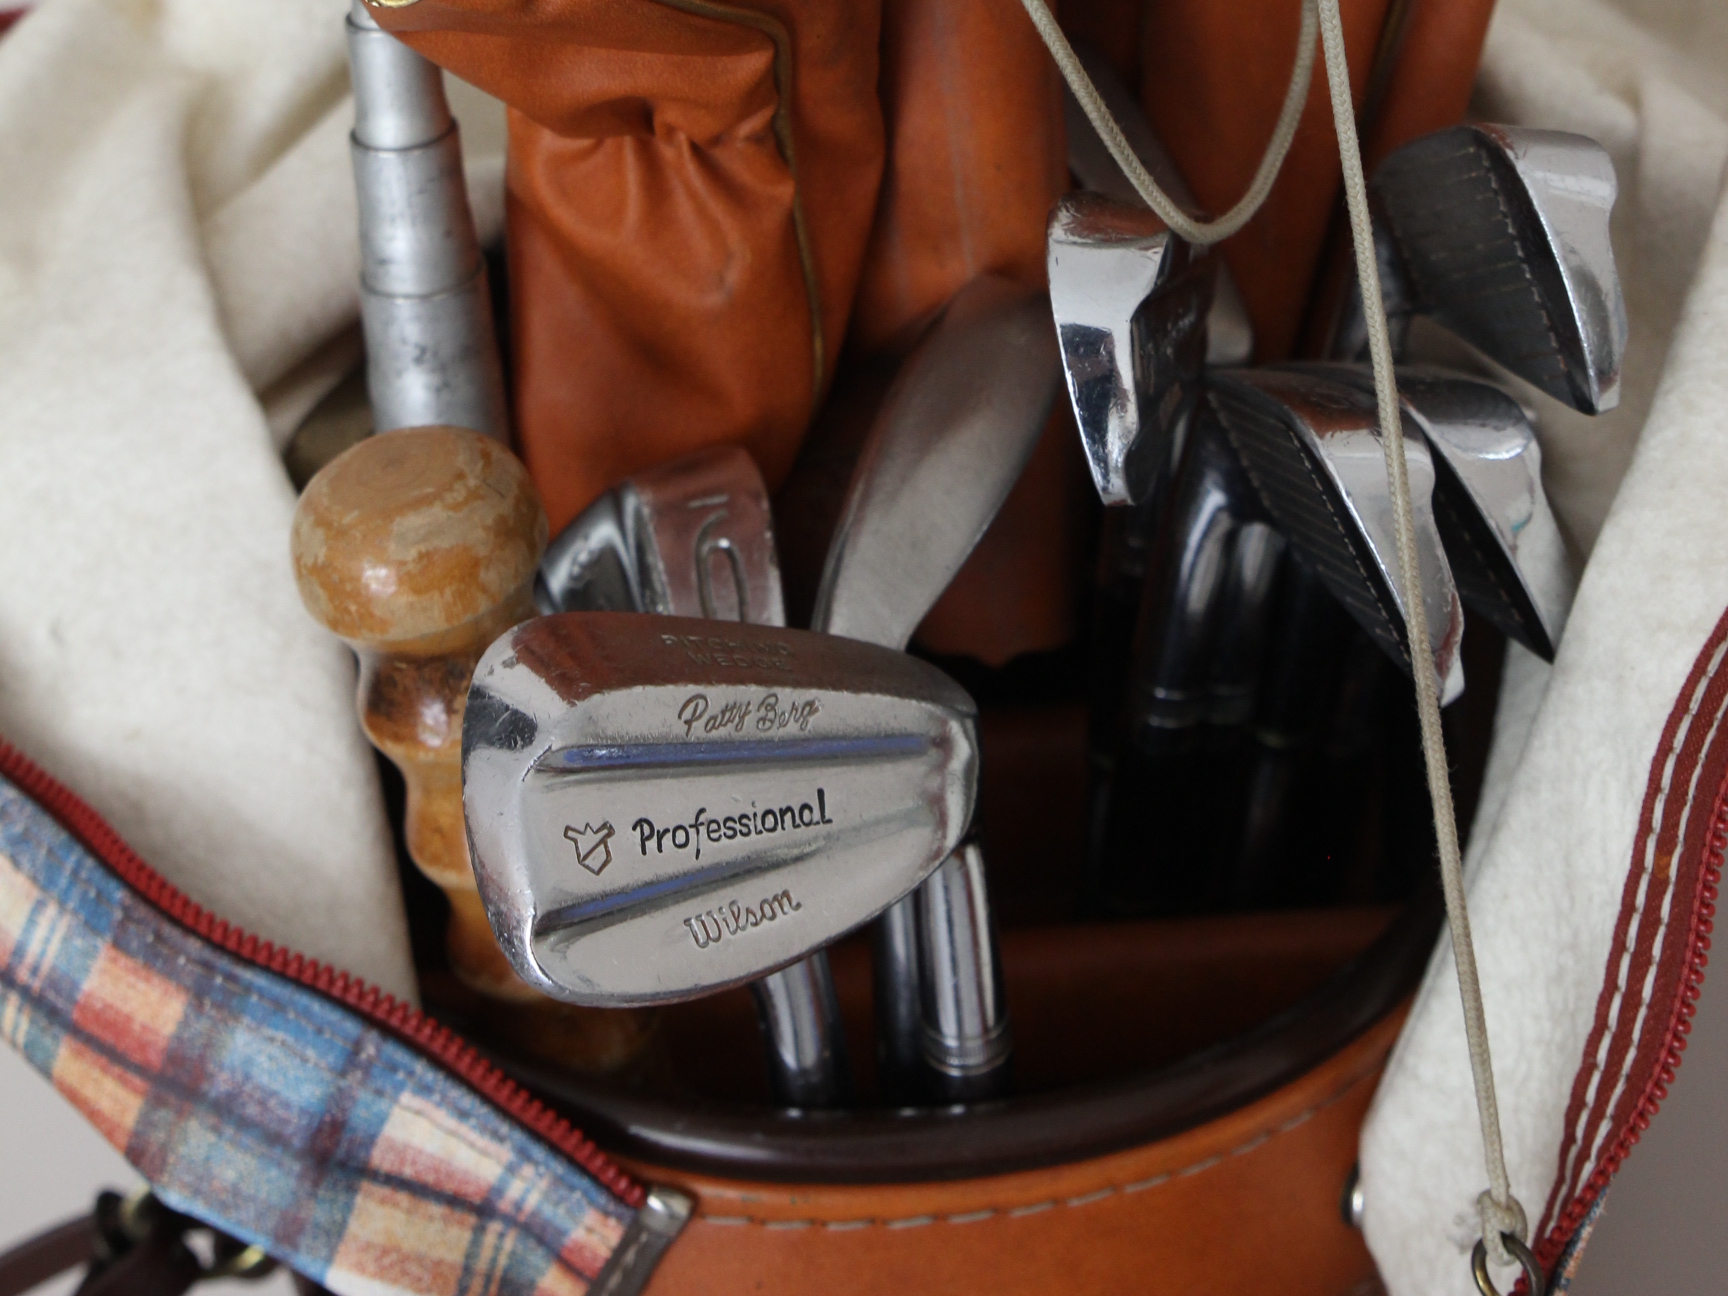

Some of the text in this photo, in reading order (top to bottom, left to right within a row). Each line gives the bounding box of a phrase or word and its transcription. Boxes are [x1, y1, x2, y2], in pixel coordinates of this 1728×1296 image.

[686, 651, 793, 672] WEDGE
[678, 692, 821, 738] Patty Berg
[631, 787, 833, 860] Professional
[683, 889, 802, 948] Wilson
